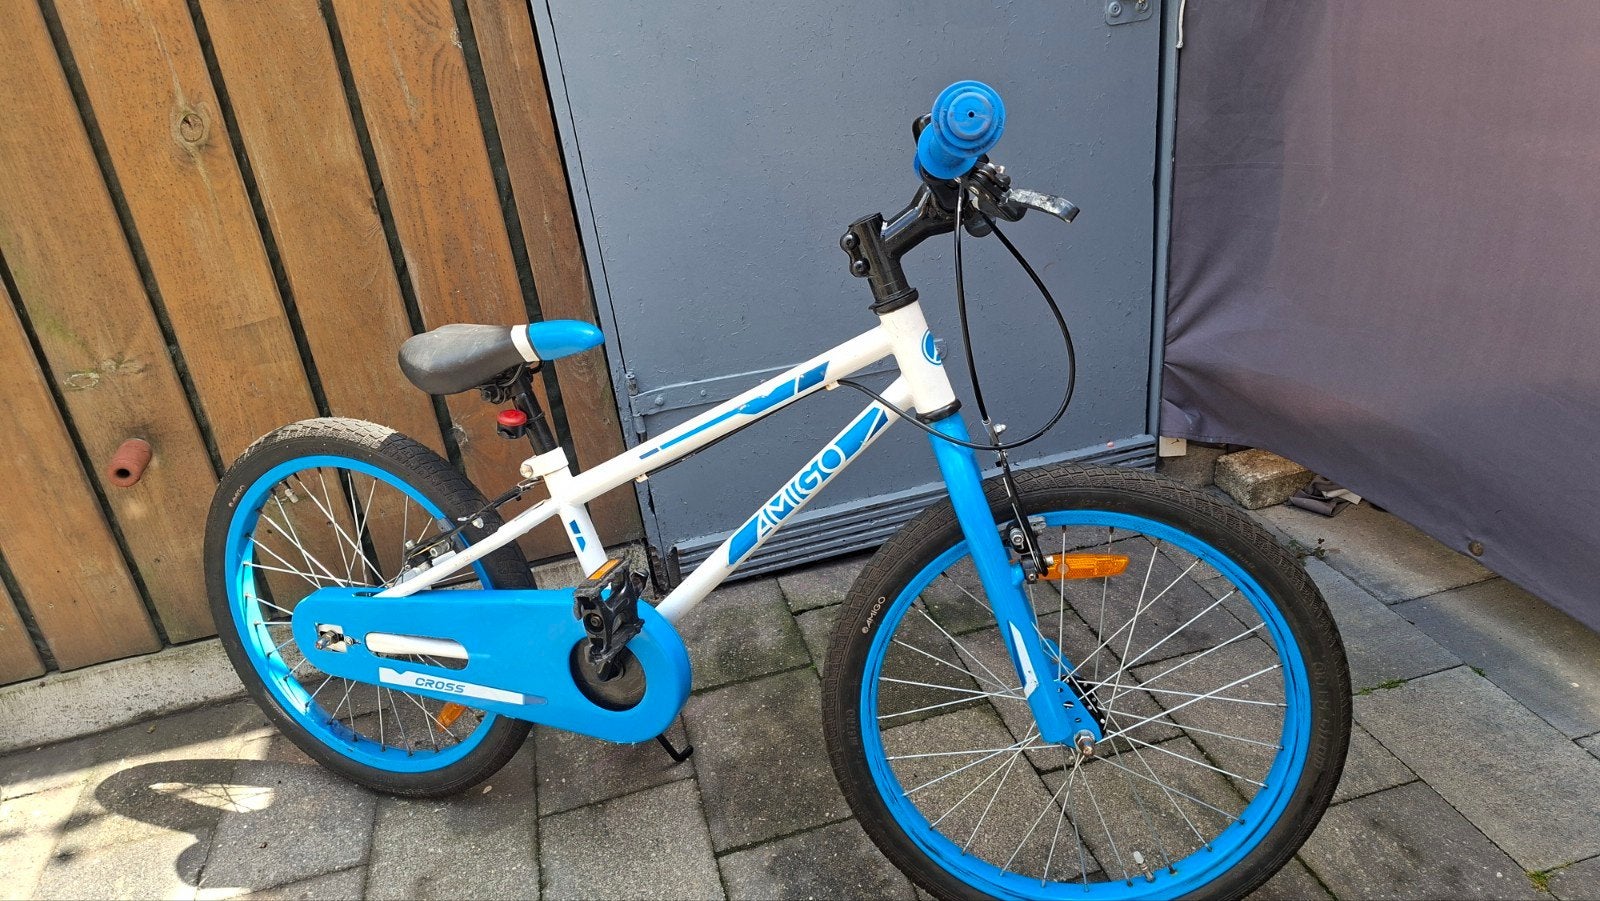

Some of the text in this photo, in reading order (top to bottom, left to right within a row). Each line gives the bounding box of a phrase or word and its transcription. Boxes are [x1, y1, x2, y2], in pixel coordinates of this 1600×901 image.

[756, 443, 846, 539] AMIGO
[865, 596, 886, 628] AMIGO
[415, 677, 466, 693] CROSS
